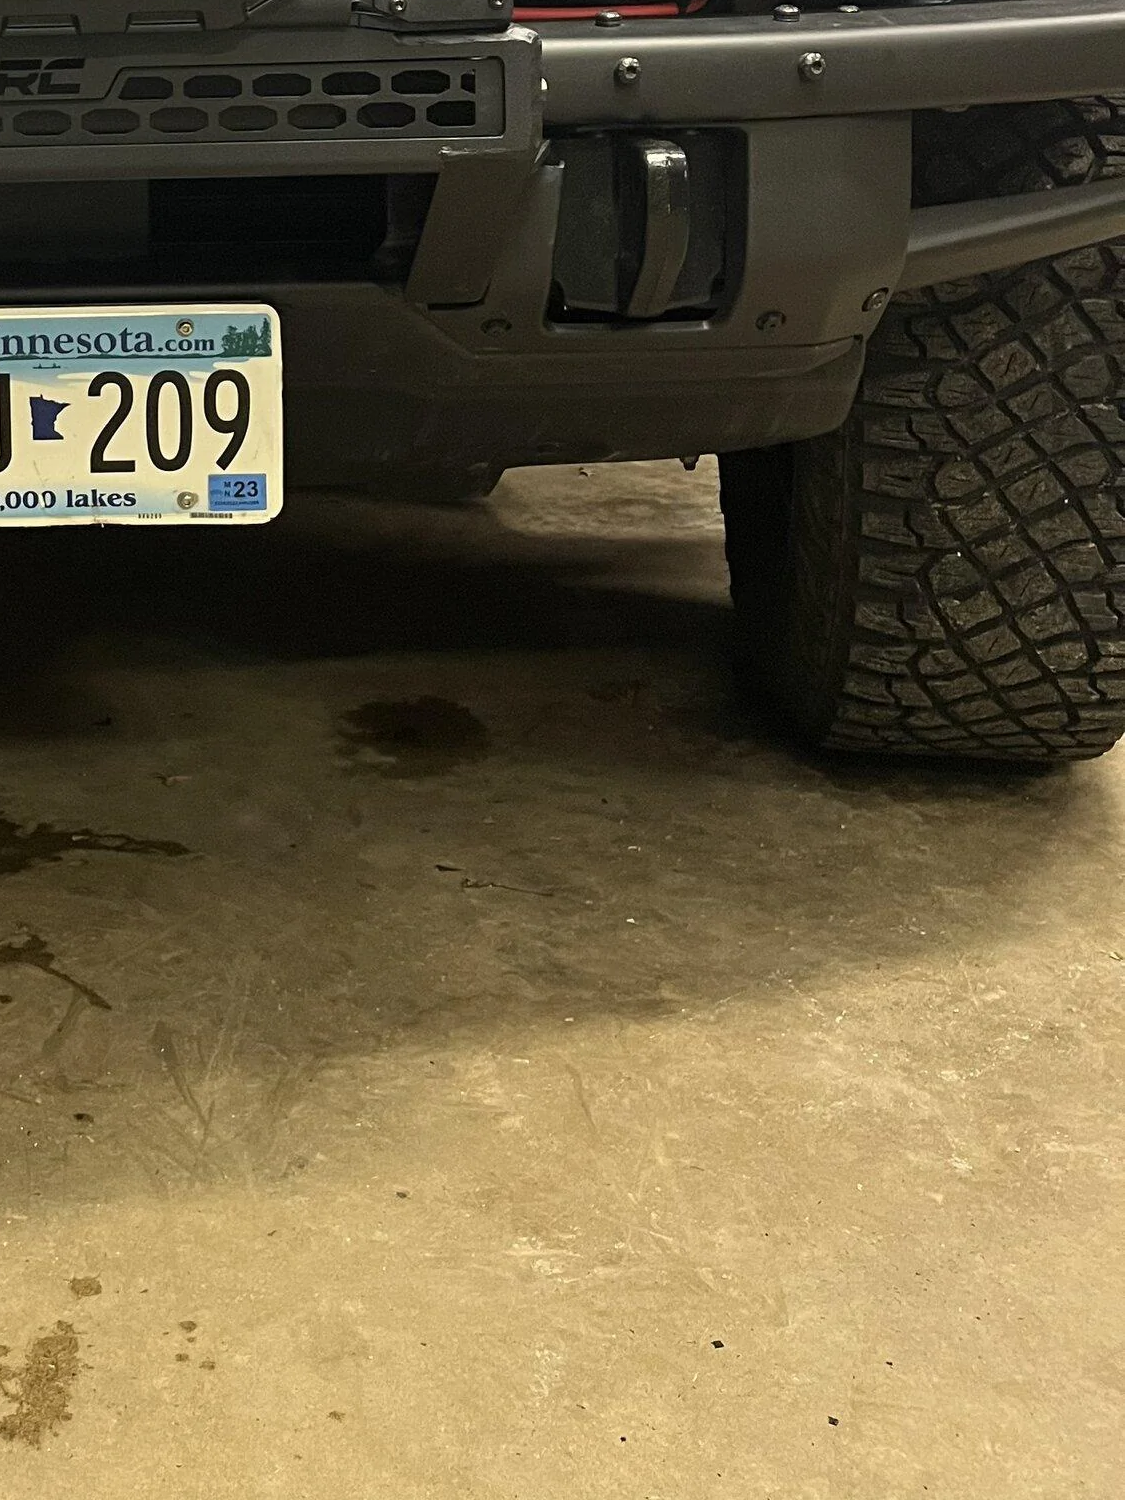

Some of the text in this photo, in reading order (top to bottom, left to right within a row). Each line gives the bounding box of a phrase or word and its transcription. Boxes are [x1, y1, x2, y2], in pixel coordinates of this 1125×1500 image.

[86, 368, 252, 473] 209
[66, 488, 137, 509] lakes
[233, 480, 260, 498] 23
